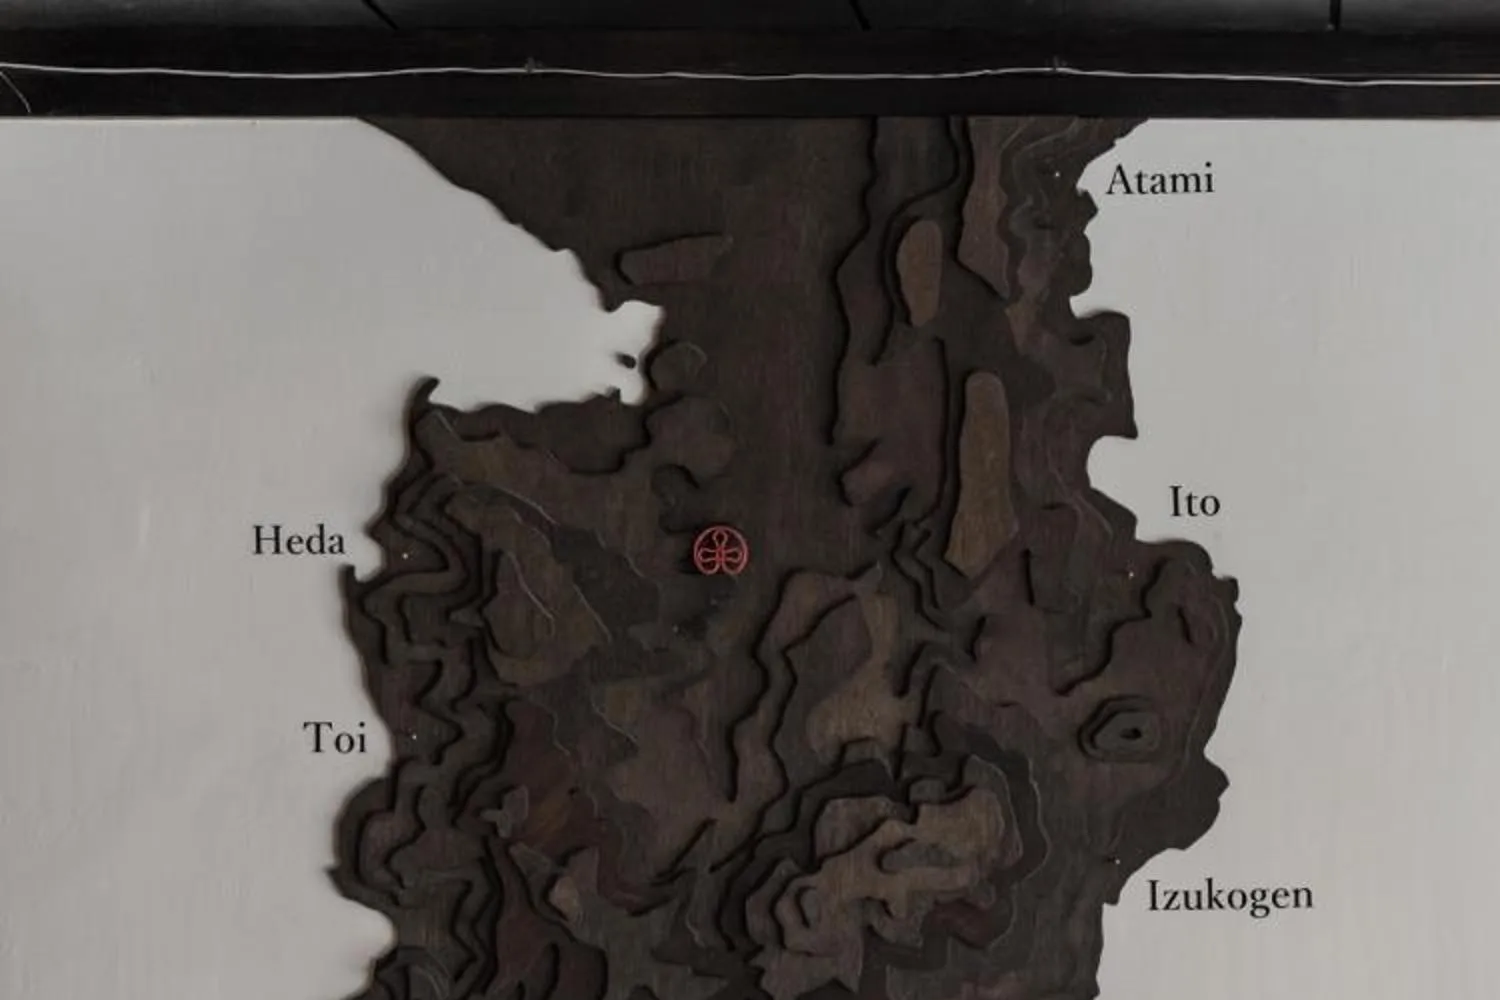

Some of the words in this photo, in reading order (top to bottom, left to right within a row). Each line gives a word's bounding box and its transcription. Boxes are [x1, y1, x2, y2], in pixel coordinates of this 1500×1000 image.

[1106, 162, 1214, 196] Atami
[1169, 485, 1221, 517] Ito
[253, 523, 346, 556] Heda
[303, 721, 366, 754] Toi
[1147, 876, 1313, 919] Izukogen
